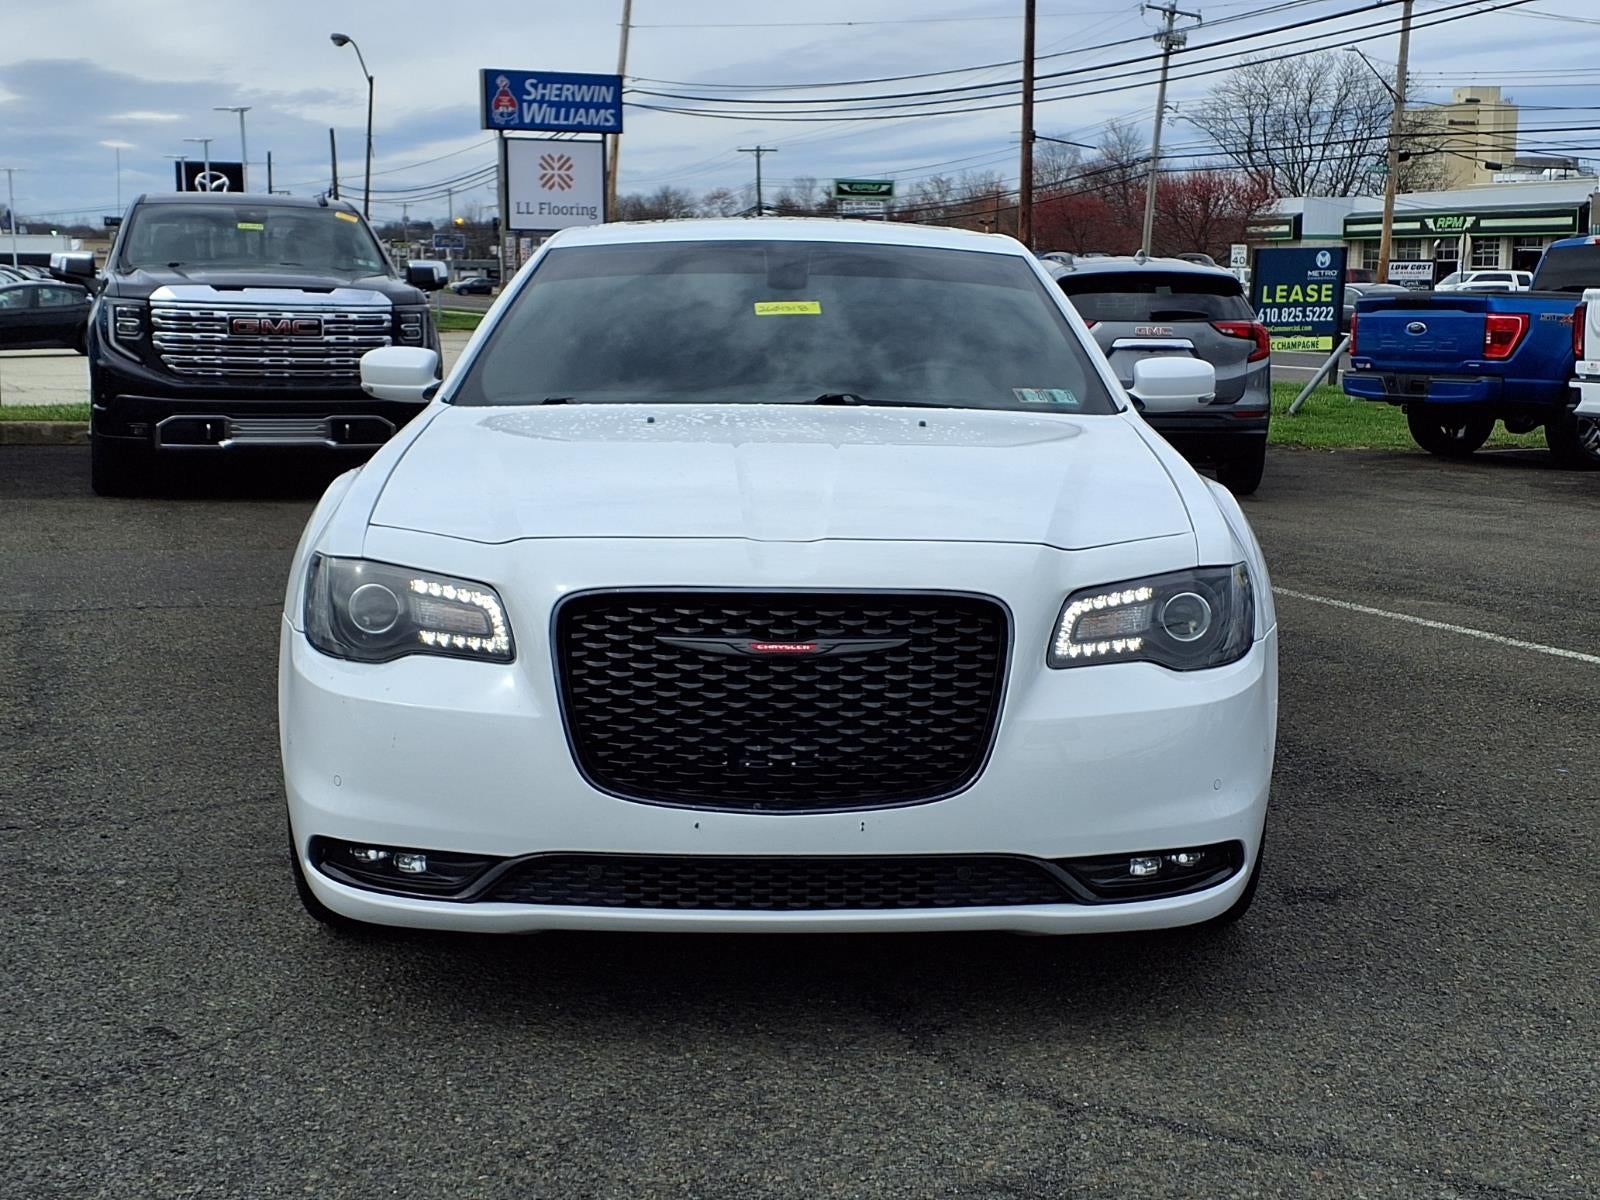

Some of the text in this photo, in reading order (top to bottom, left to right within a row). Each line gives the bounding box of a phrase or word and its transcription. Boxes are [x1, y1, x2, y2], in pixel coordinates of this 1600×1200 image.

[522, 78, 615, 103] SHERWIN
[522, 102, 616, 126] WILLIAMS
[516, 202, 598, 220] LL Flooring
[1436, 215, 1464, 228] RPM
[1231, 256, 1246, 265] 40
[1307, 269, 1337, 277] METRO
[1262, 284, 1334, 303] LEASE
[1258, 306, 1334, 323] 610.825.5222
[232, 318, 319, 334] GMC
[1135, 326, 1173, 336] GMC
[1277, 340, 1320, 350] CHAMPAGNE
